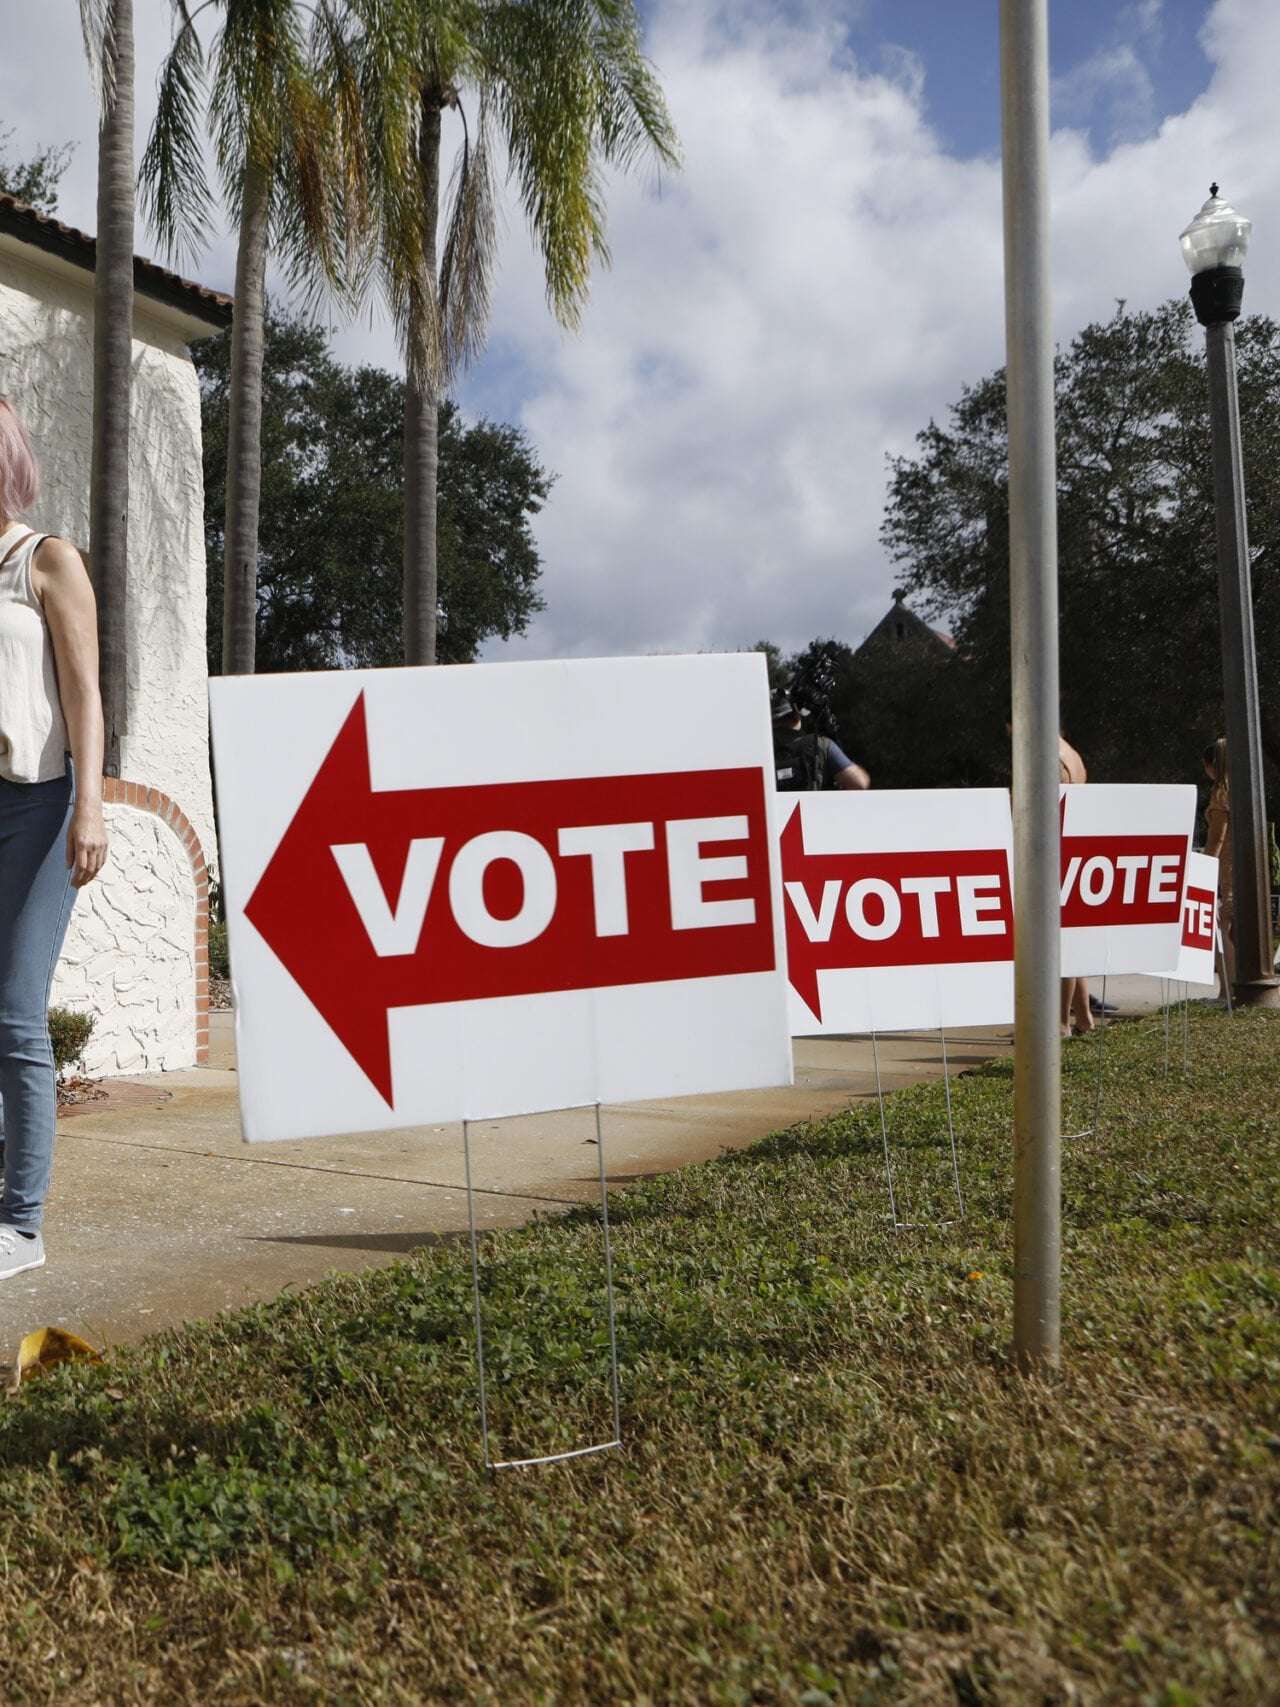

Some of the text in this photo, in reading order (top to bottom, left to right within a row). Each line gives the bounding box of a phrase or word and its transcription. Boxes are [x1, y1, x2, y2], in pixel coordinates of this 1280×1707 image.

[330, 815, 756, 957] VOTE
[783, 874, 1007, 943] VOTE
[1060, 855, 1181, 907] VOTE
